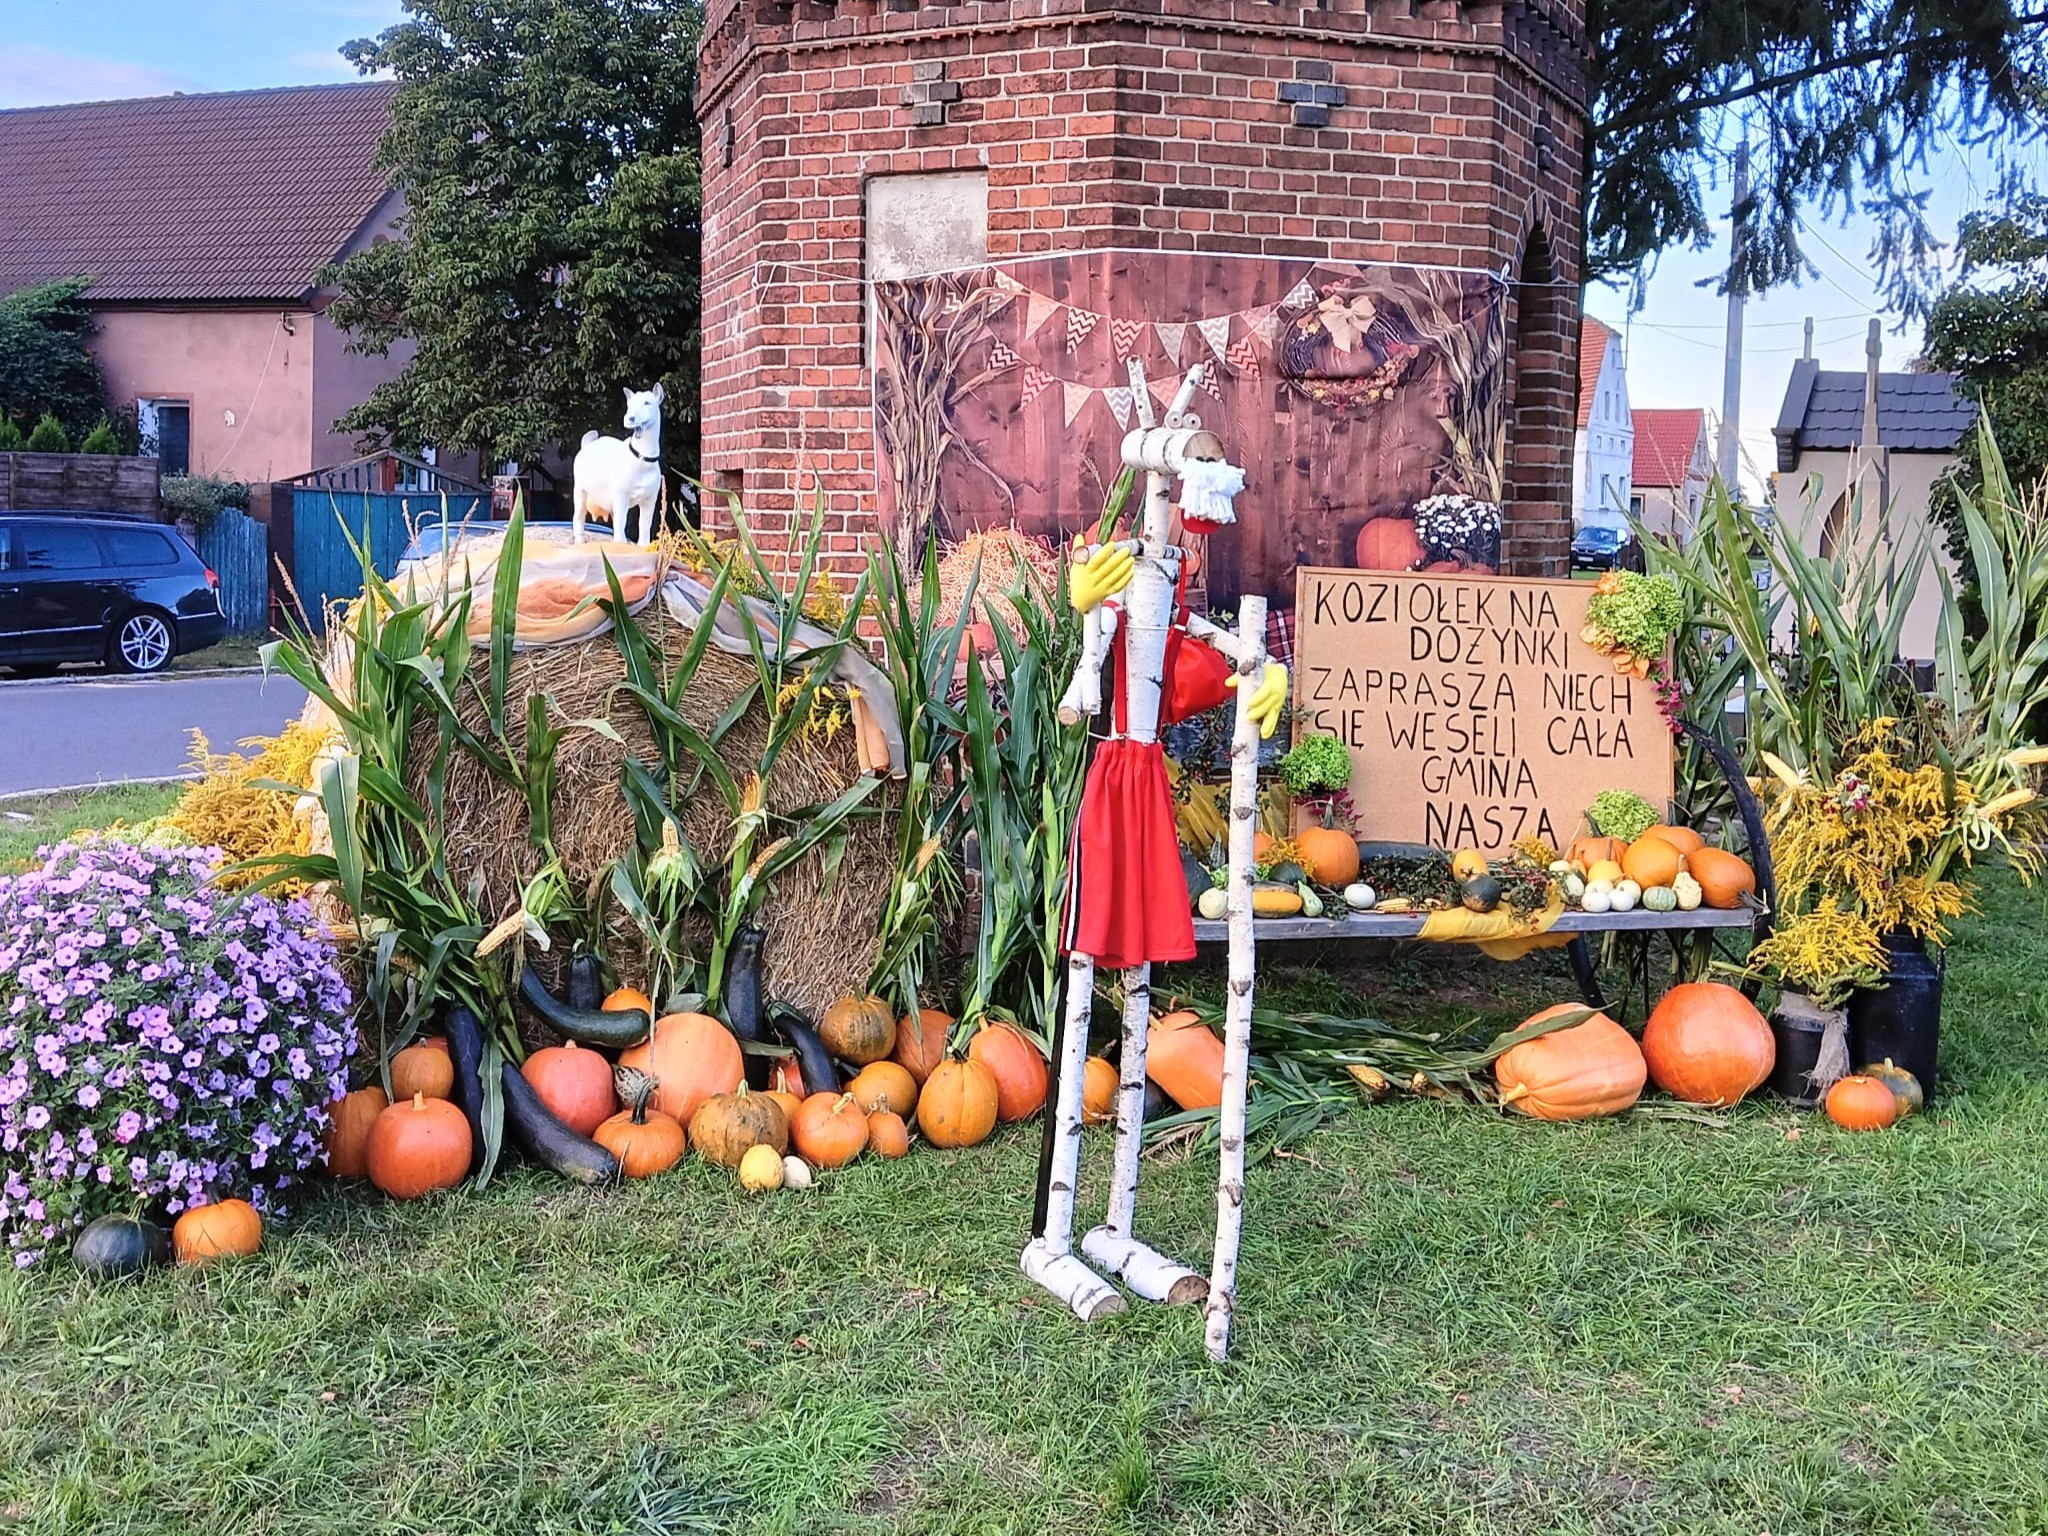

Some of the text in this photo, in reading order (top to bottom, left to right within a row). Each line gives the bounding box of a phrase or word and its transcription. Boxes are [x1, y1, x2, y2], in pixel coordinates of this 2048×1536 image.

[1314, 581, 1560, 628] KOZIOŁEK NA
[1310, 667, 1632, 715] ZAPRASZA NIECH
[1386, 711, 1516, 758] WESELI
[1546, 716, 1634, 758] CAŁA
[1421, 755, 1538, 799] GMINA
[1425, 801, 1559, 850] NASZA
